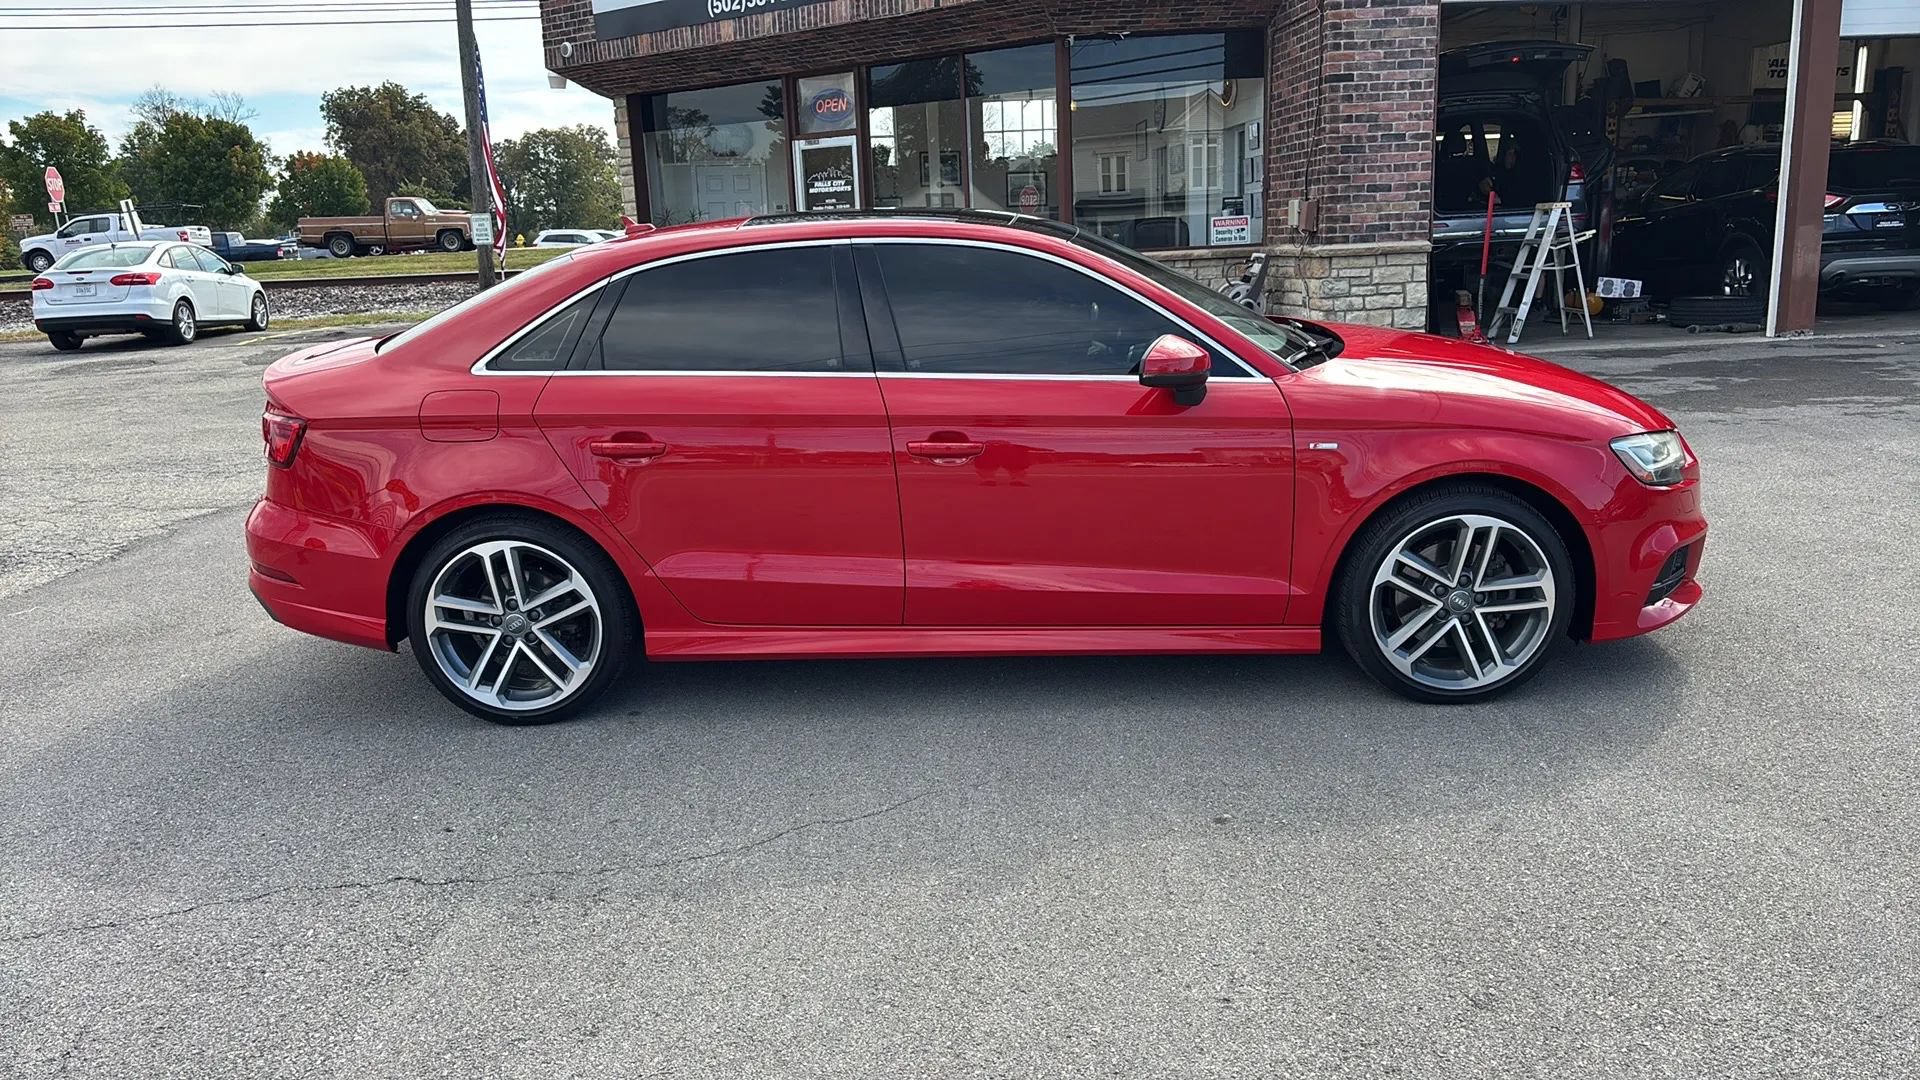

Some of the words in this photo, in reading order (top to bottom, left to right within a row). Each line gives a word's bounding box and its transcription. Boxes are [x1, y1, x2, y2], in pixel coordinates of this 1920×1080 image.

[816, 98, 847, 113] OPEN
[47, 177, 63, 192] STOP
[809, 185, 852, 193] MOTORSPORTS
[1214, 218, 1247, 227] WARNING
